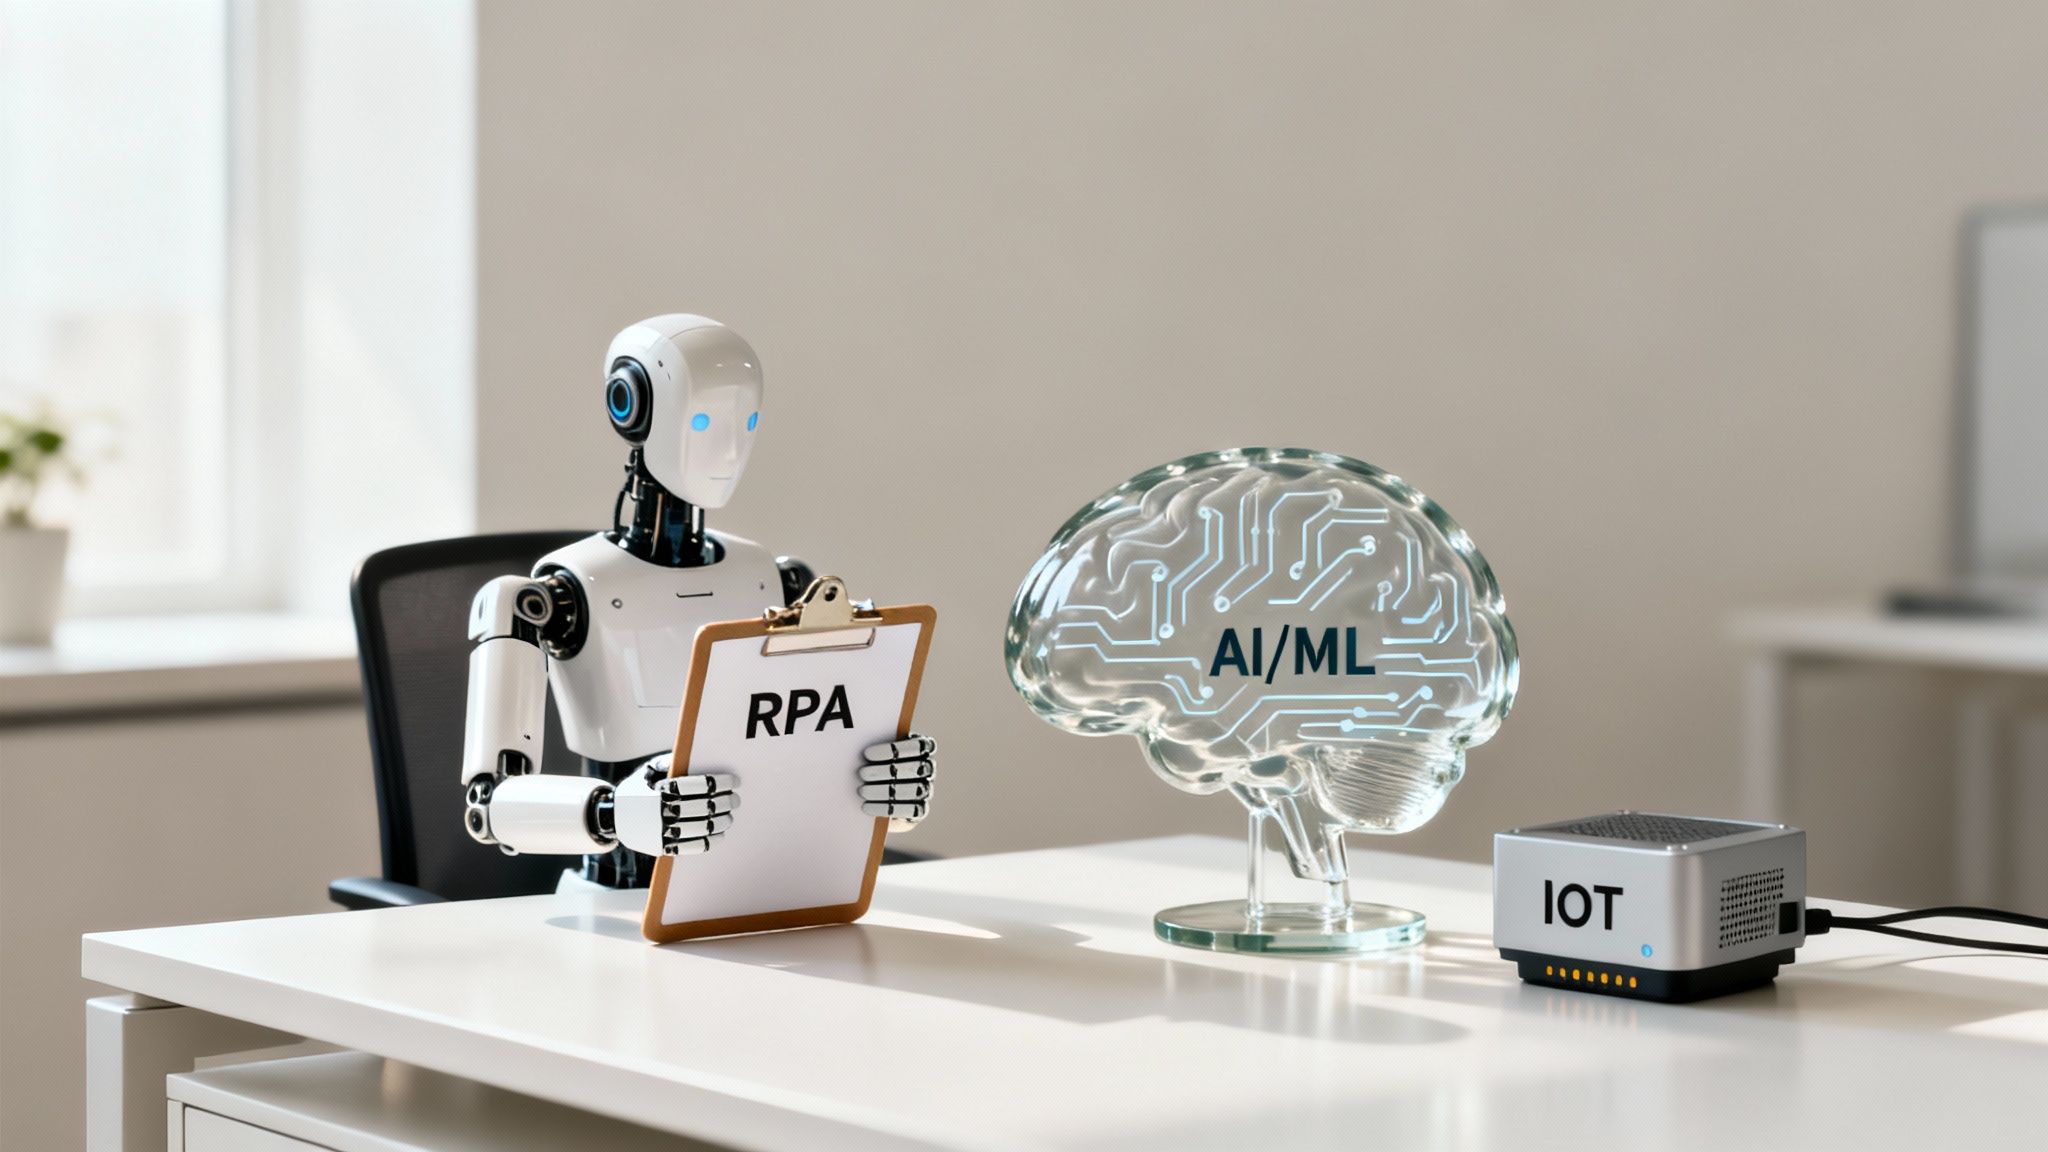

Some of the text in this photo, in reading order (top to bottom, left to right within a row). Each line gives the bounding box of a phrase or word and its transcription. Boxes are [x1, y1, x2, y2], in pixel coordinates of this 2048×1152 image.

[1209, 624, 1376, 685] AI/ML
[745, 684, 854, 739] RPA
[1544, 879, 1624, 930] IOT
